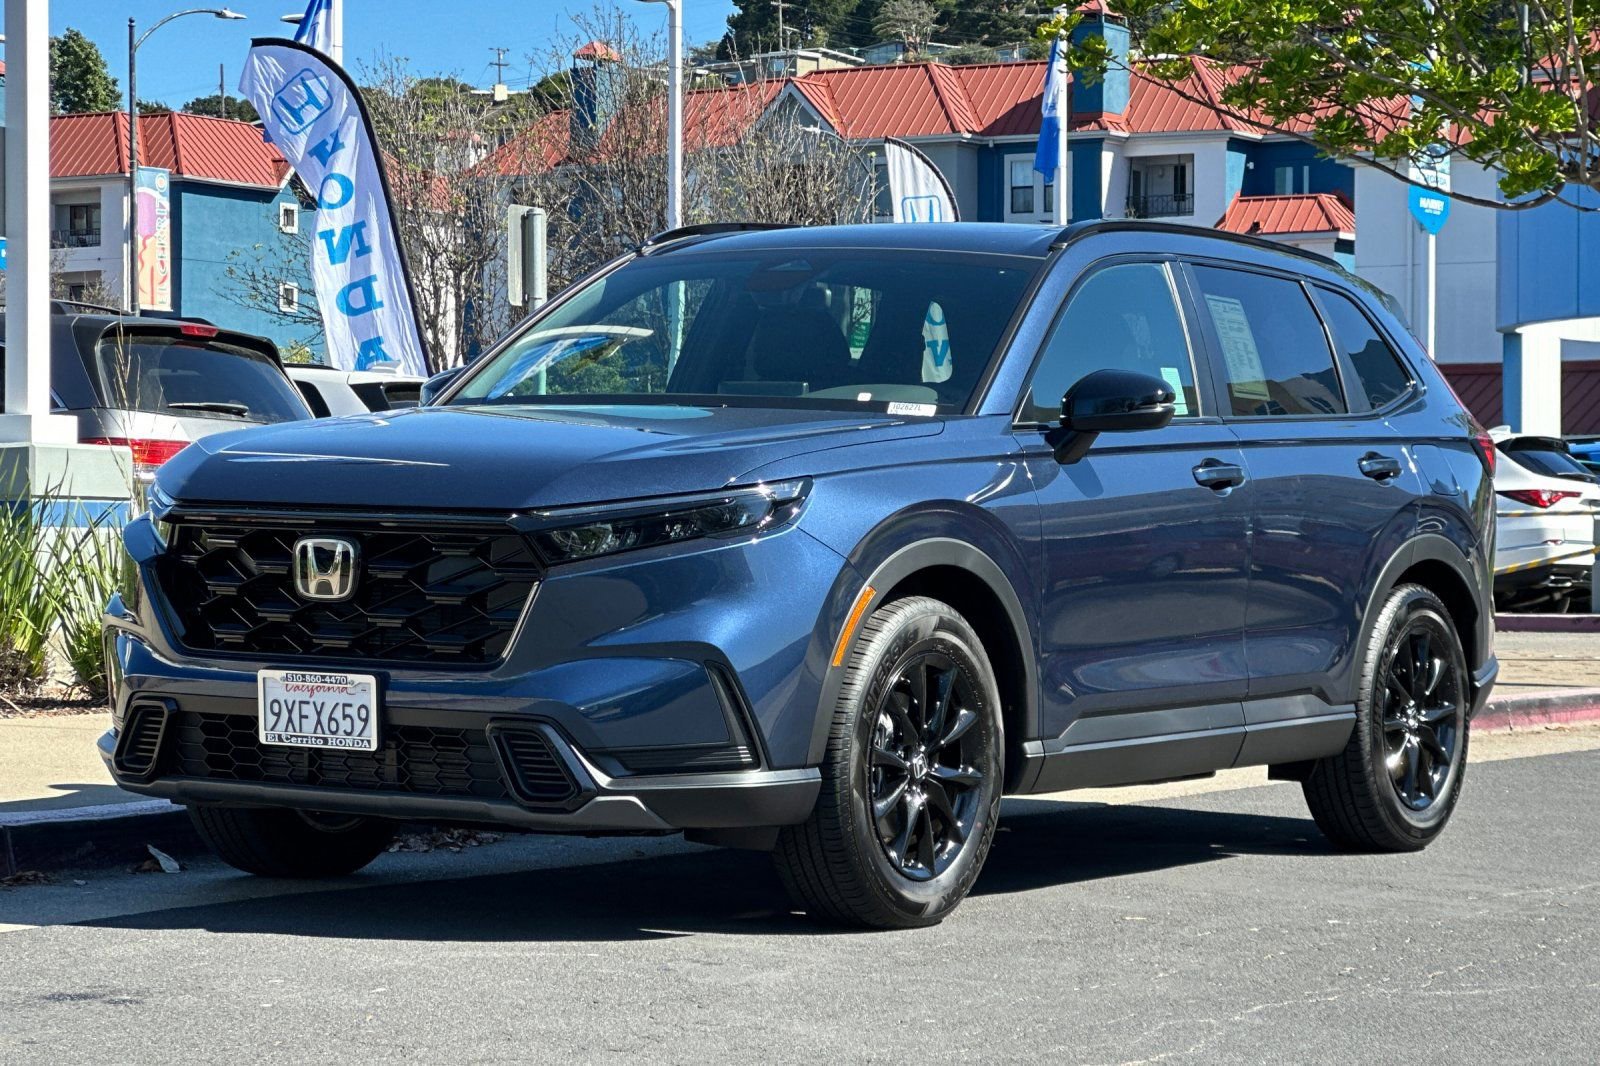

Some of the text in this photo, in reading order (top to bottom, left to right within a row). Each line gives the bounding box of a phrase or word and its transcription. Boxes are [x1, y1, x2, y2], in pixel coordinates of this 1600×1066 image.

[287, 673, 348, 685] 510-860-4470
[285, 683, 356, 698] California
[269, 698, 370, 737] 9XFX659
[267, 734, 370, 748] El Cerrito HONDA
